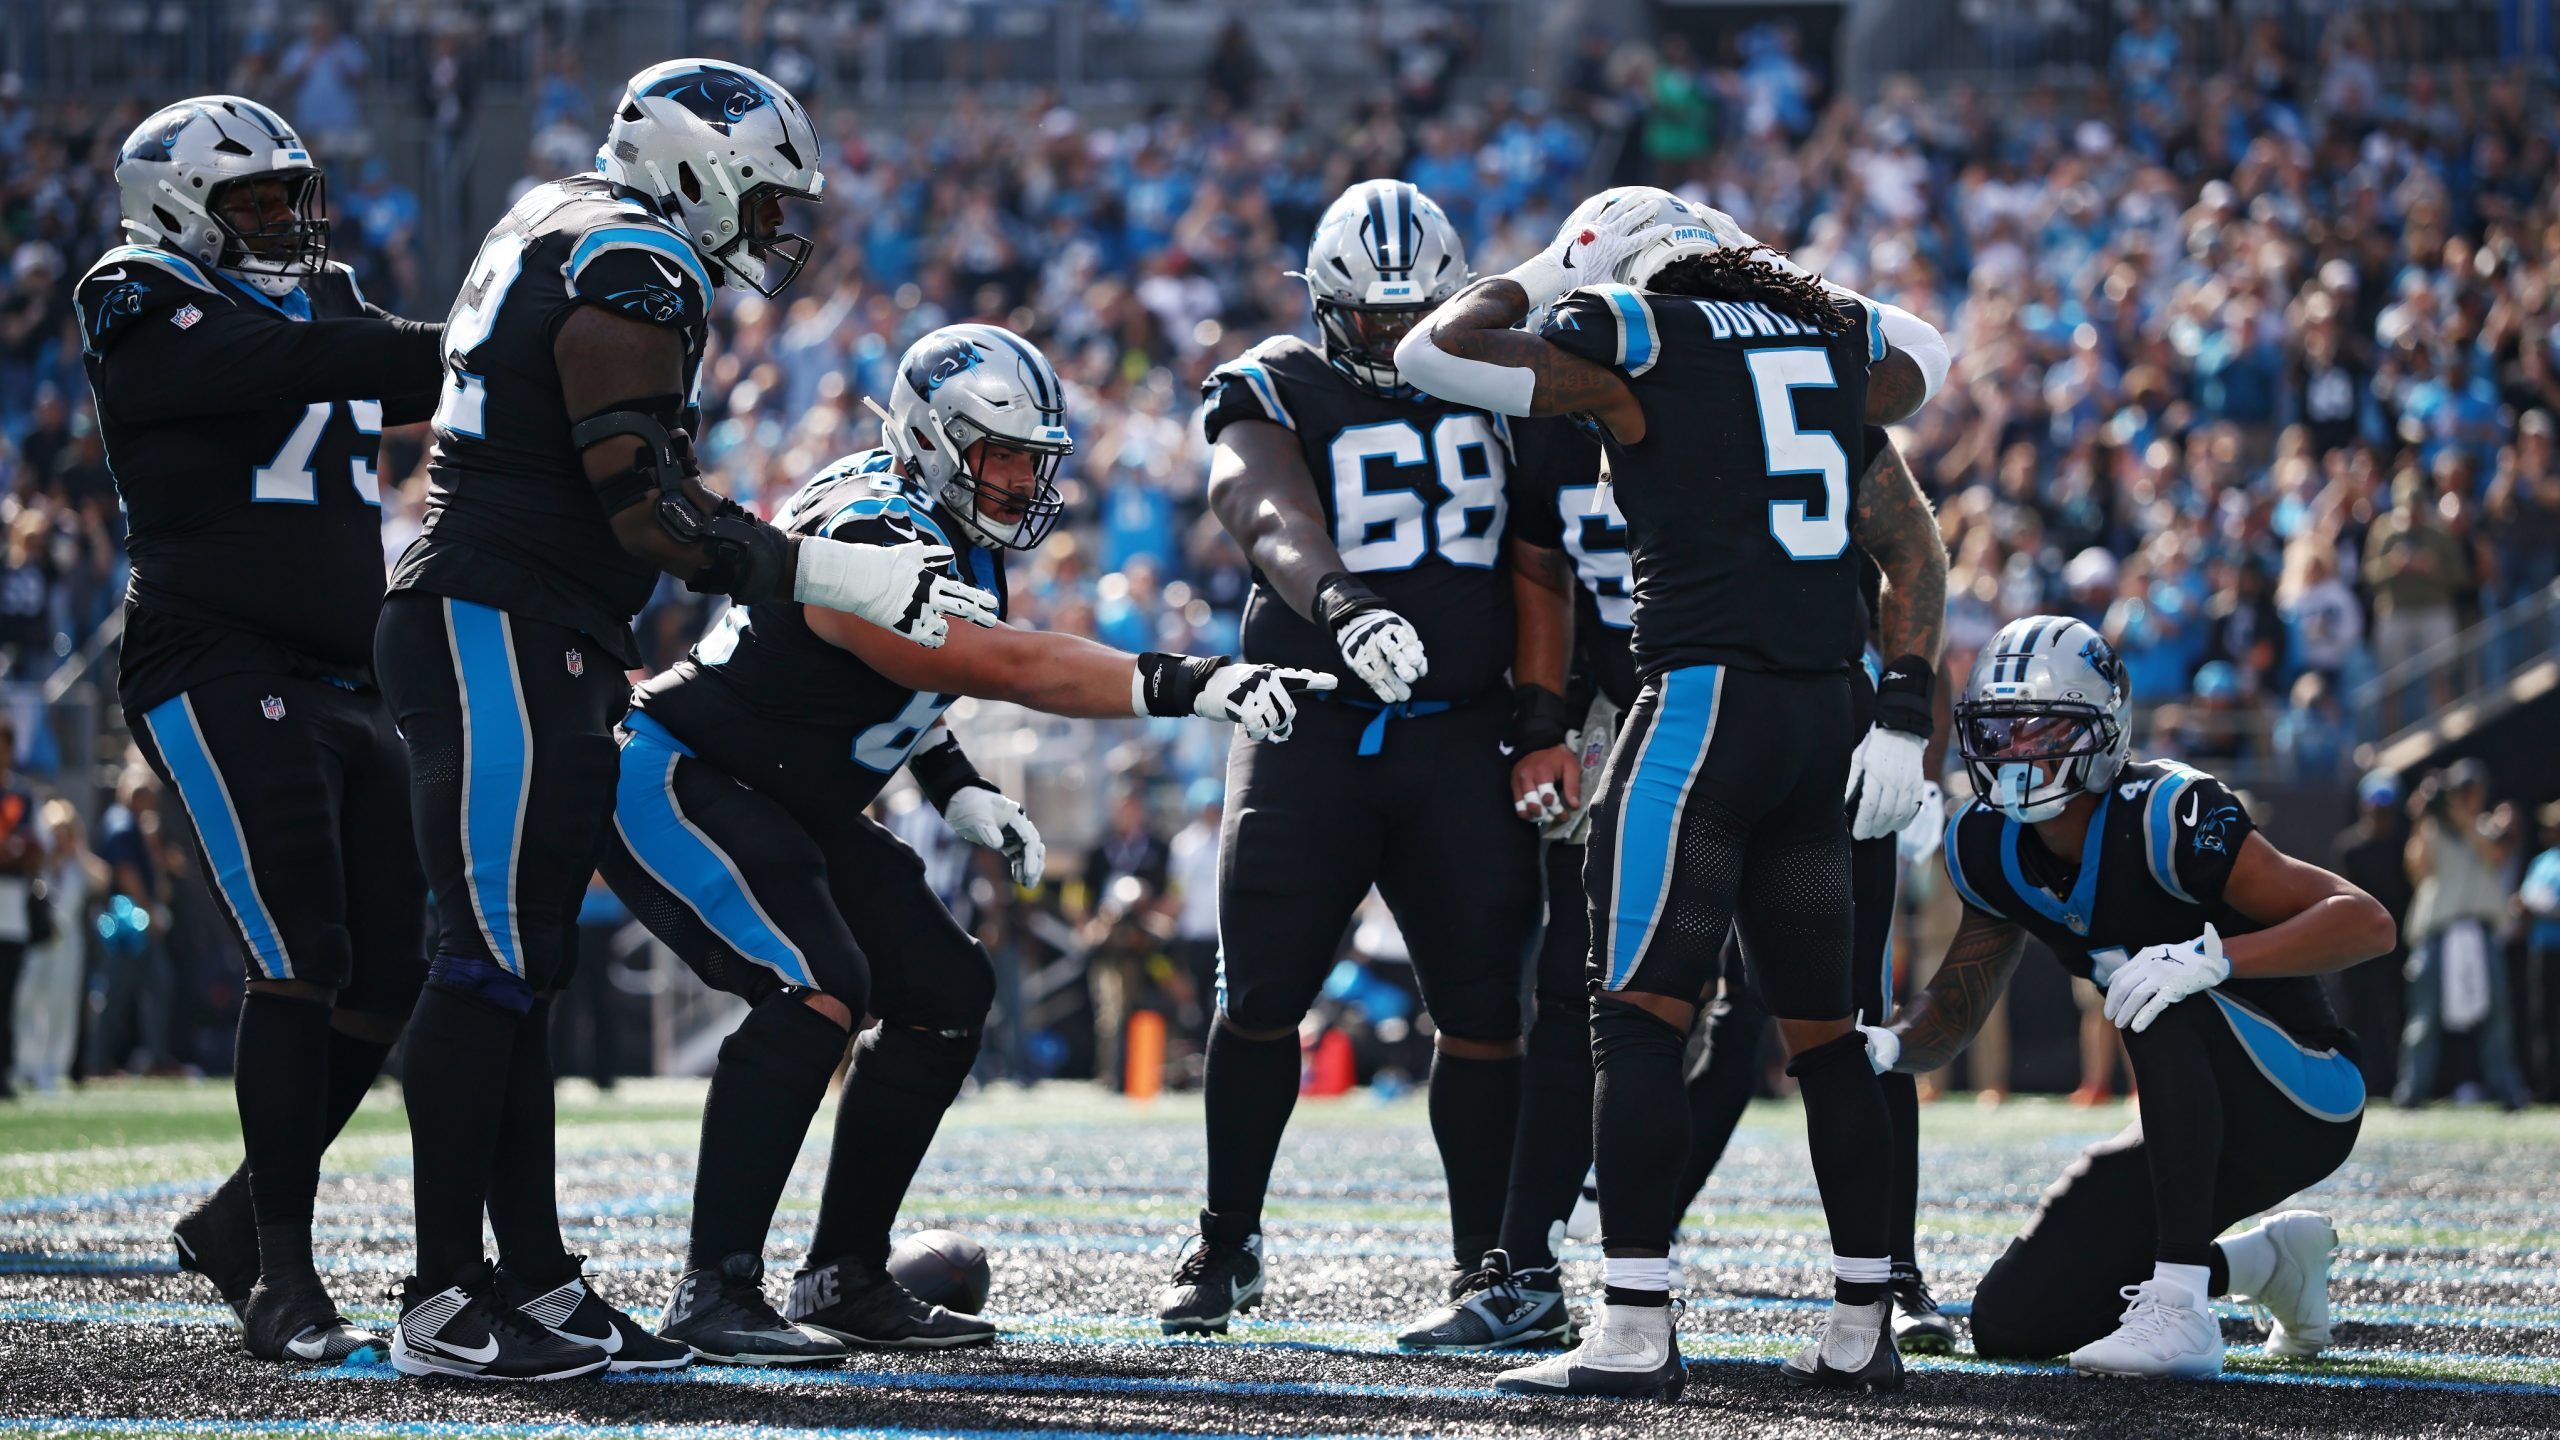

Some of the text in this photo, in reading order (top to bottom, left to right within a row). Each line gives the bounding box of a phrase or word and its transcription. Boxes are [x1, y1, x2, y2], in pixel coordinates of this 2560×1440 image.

[1691, 299, 1840, 340] DOWD
[1743, 346, 1850, 561] 5
[1328, 412, 1509, 573] 68
[2118, 778, 2154, 801] 4
[403, 1349, 433, 1364] ALPHA
